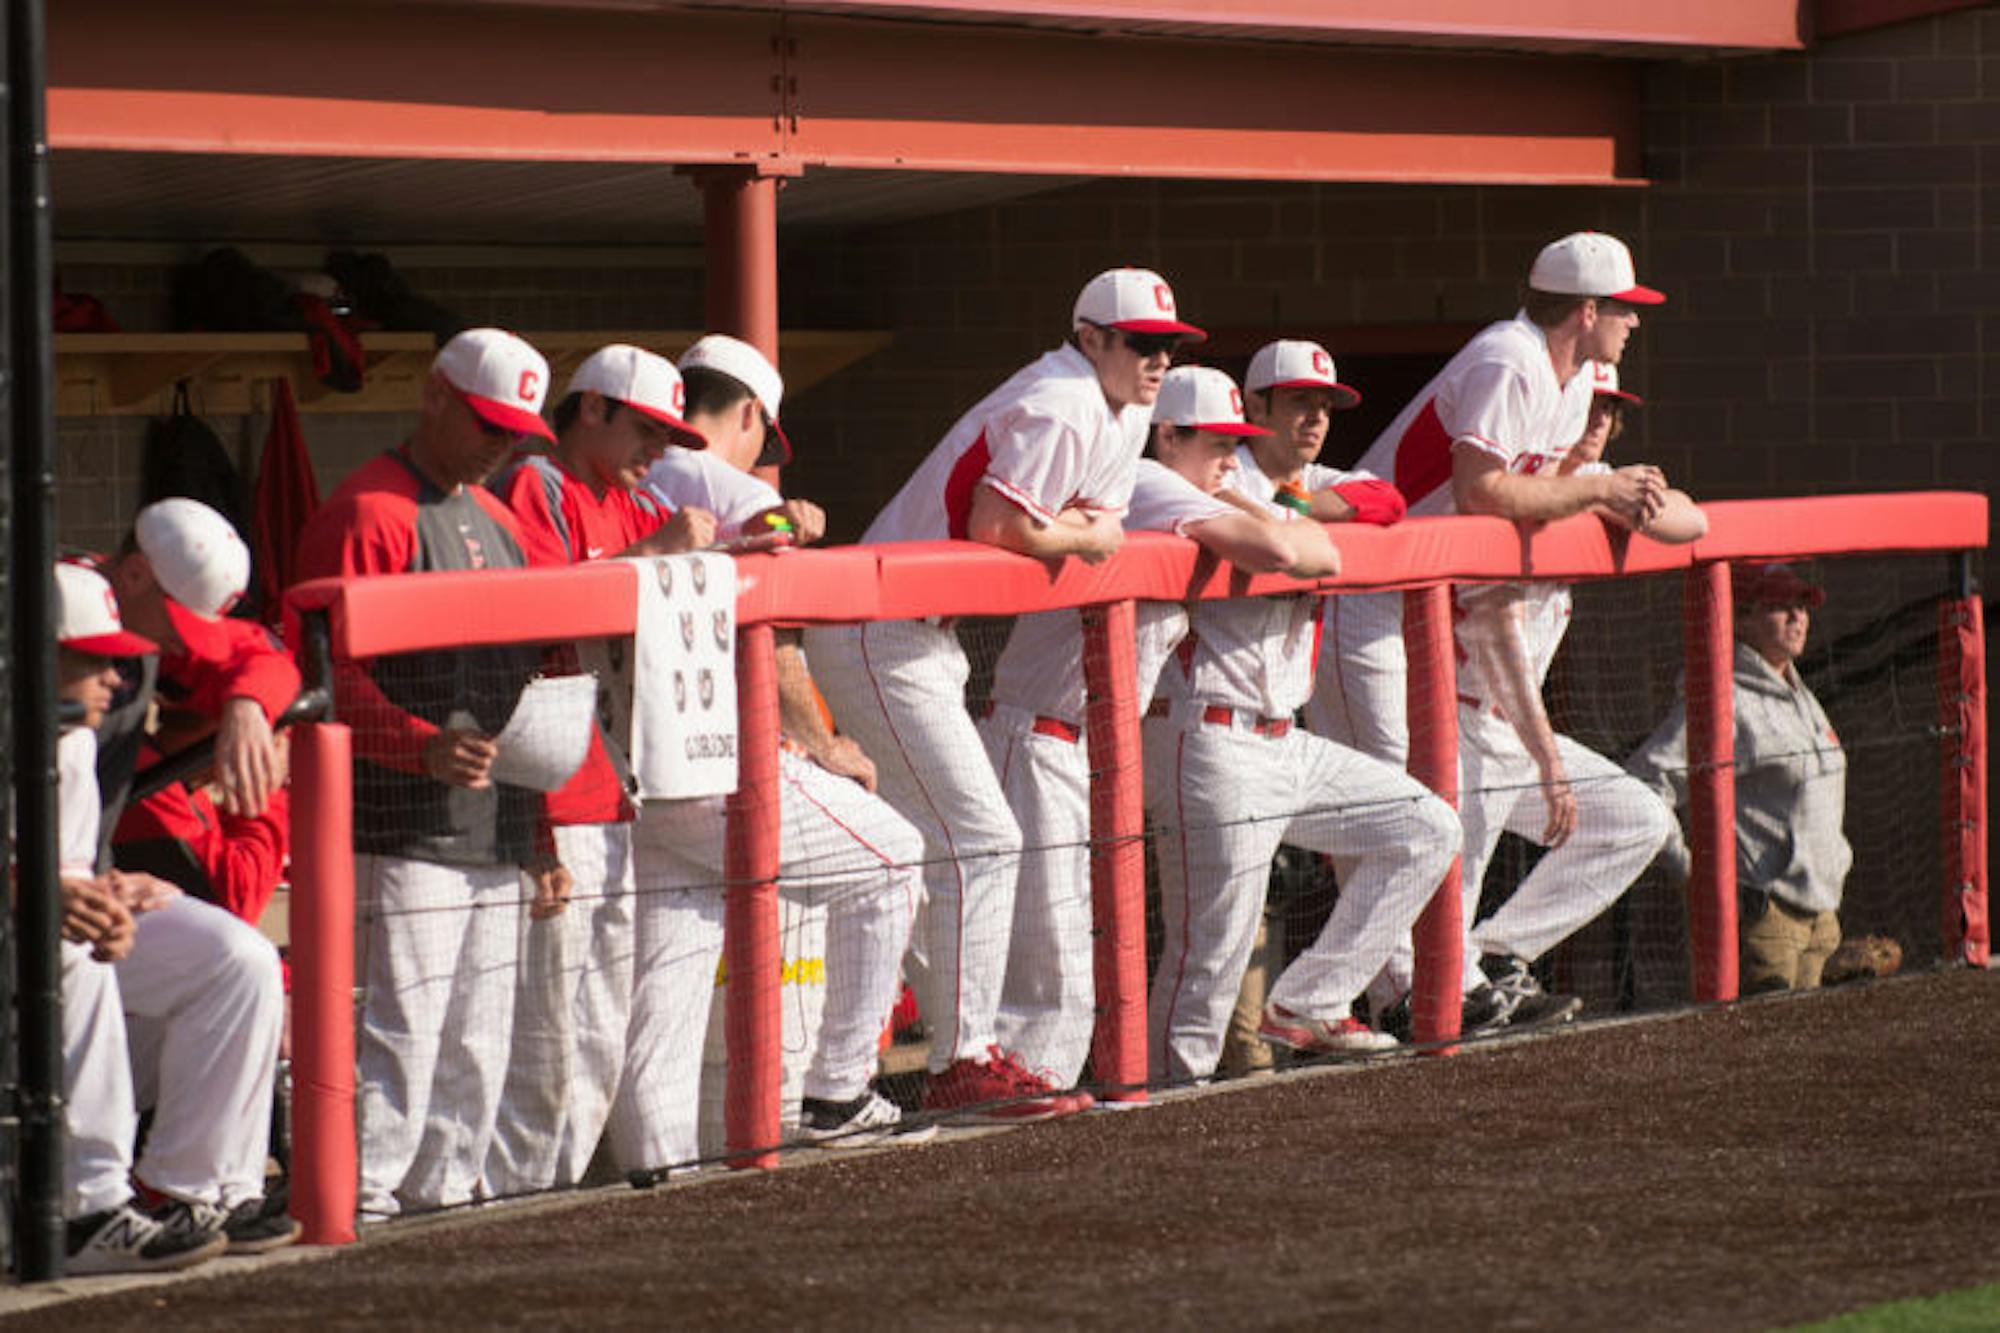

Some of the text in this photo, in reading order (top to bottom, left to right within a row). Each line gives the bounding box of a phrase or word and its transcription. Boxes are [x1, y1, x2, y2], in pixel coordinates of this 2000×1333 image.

[1153, 283, 1173, 312] C
[1312, 351, 1329, 376] C
[519, 369, 540, 402] C
[1229, 388, 1244, 416] C
